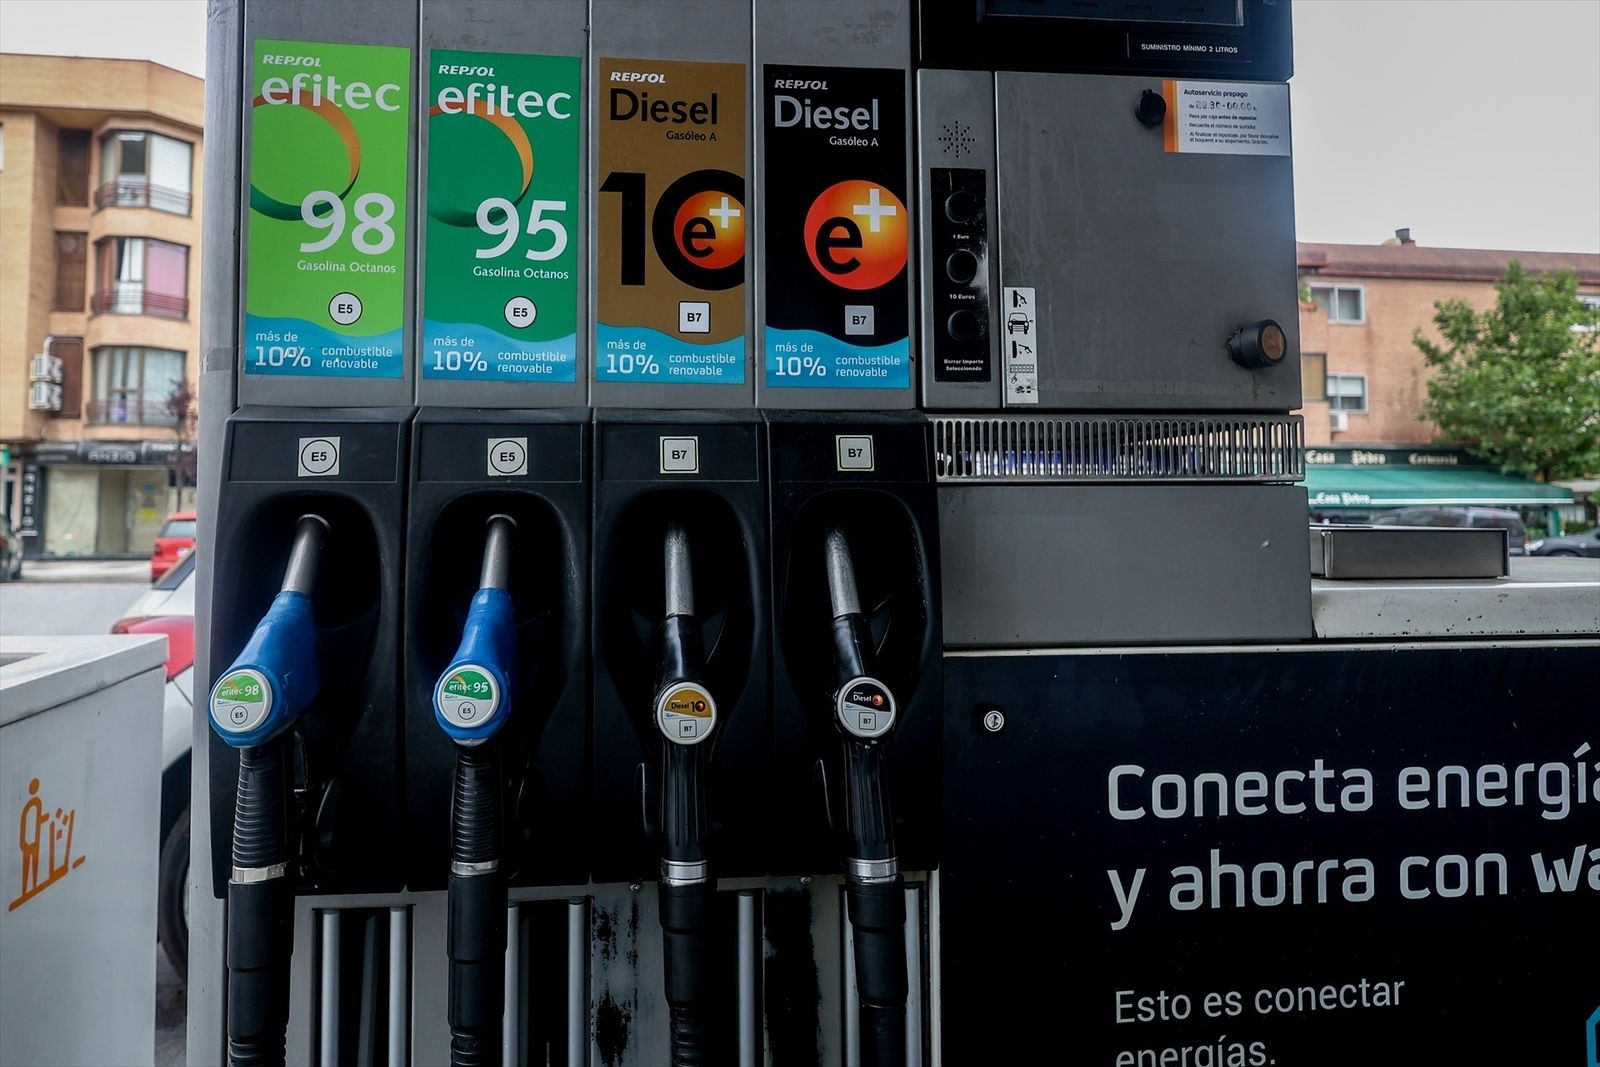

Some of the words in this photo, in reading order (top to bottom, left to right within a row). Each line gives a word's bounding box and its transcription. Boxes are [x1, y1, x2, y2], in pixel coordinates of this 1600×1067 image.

[262, 55, 322, 67] REPSOL
[438, 65, 495, 76] REPSOL
[610, 72, 665, 83] REPSOL
[775, 80, 828, 90] REPSOL
[262, 74, 400, 111] efitec
[438, 83, 571, 119] efitec
[610, 88, 718, 125] Diesel
[775, 95, 878, 130] Diesel
[666, 130, 706, 141] Gasóleo
[709, 133, 717, 141] A
[829, 136, 868, 146] Gasóleo
[871, 138, 878, 146] A
[300, 191, 395, 254] 98
[476, 198, 567, 261] 95
[297, 261, 345, 271] Gasolina
[350, 262, 396, 273] Octanos
[473, 267, 520, 277] Gasolina
[524, 268, 568, 279] Octanos
[338, 304, 353, 313] E5
[513, 308, 527, 317] E5
[687, 313, 701, 322] B7
[852, 316, 867, 325] B7
[256, 331, 280, 341] más
[284, 332, 298, 341] de
[434, 336, 458, 346] más
[461, 337, 475, 346] de
[607, 339, 631, 350] más
[633, 340, 646, 350] de
[776, 342, 798, 352] más
[800, 343, 813, 352] de
[255, 346, 311, 367] 10%
[322, 346, 392, 357] combustible
[498, 351, 566, 362] combustible
[322, 357, 378, 369] renovable
[433, 351, 487, 371] 10%
[669, 353, 735, 363] combustible
[836, 355, 900, 366] combustible
[498, 363, 552, 374] renovable
[607, 354, 659, 375] 10%
[776, 357, 826, 376] 10%
[669, 365, 722, 376] renovable
[836, 367, 887, 377] renovable
[311, 452, 327, 462] E5
[500, 452, 515, 462] E5
[672, 450, 687, 460] B7
[848, 448, 863, 458] B7
[245, 684, 259, 696] 98
[473, 682, 489, 693] 95
[853, 694, 872, 702] Diesel
[671, 702, 689, 710] Diesel
[1107, 759, 1374, 820] Conecta
[1398, 742, 1600, 820] energí
[1107, 868, 1146, 930] y
[1169, 849, 1375, 910] ahorra
[1399, 853, 1508, 899] con
[1115, 989, 1192, 1024] Esto
[1203, 990, 1242, 1018] es
[1254, 978, 1405, 1014] conectar
[1116, 1035, 1275, 1067] energías.
